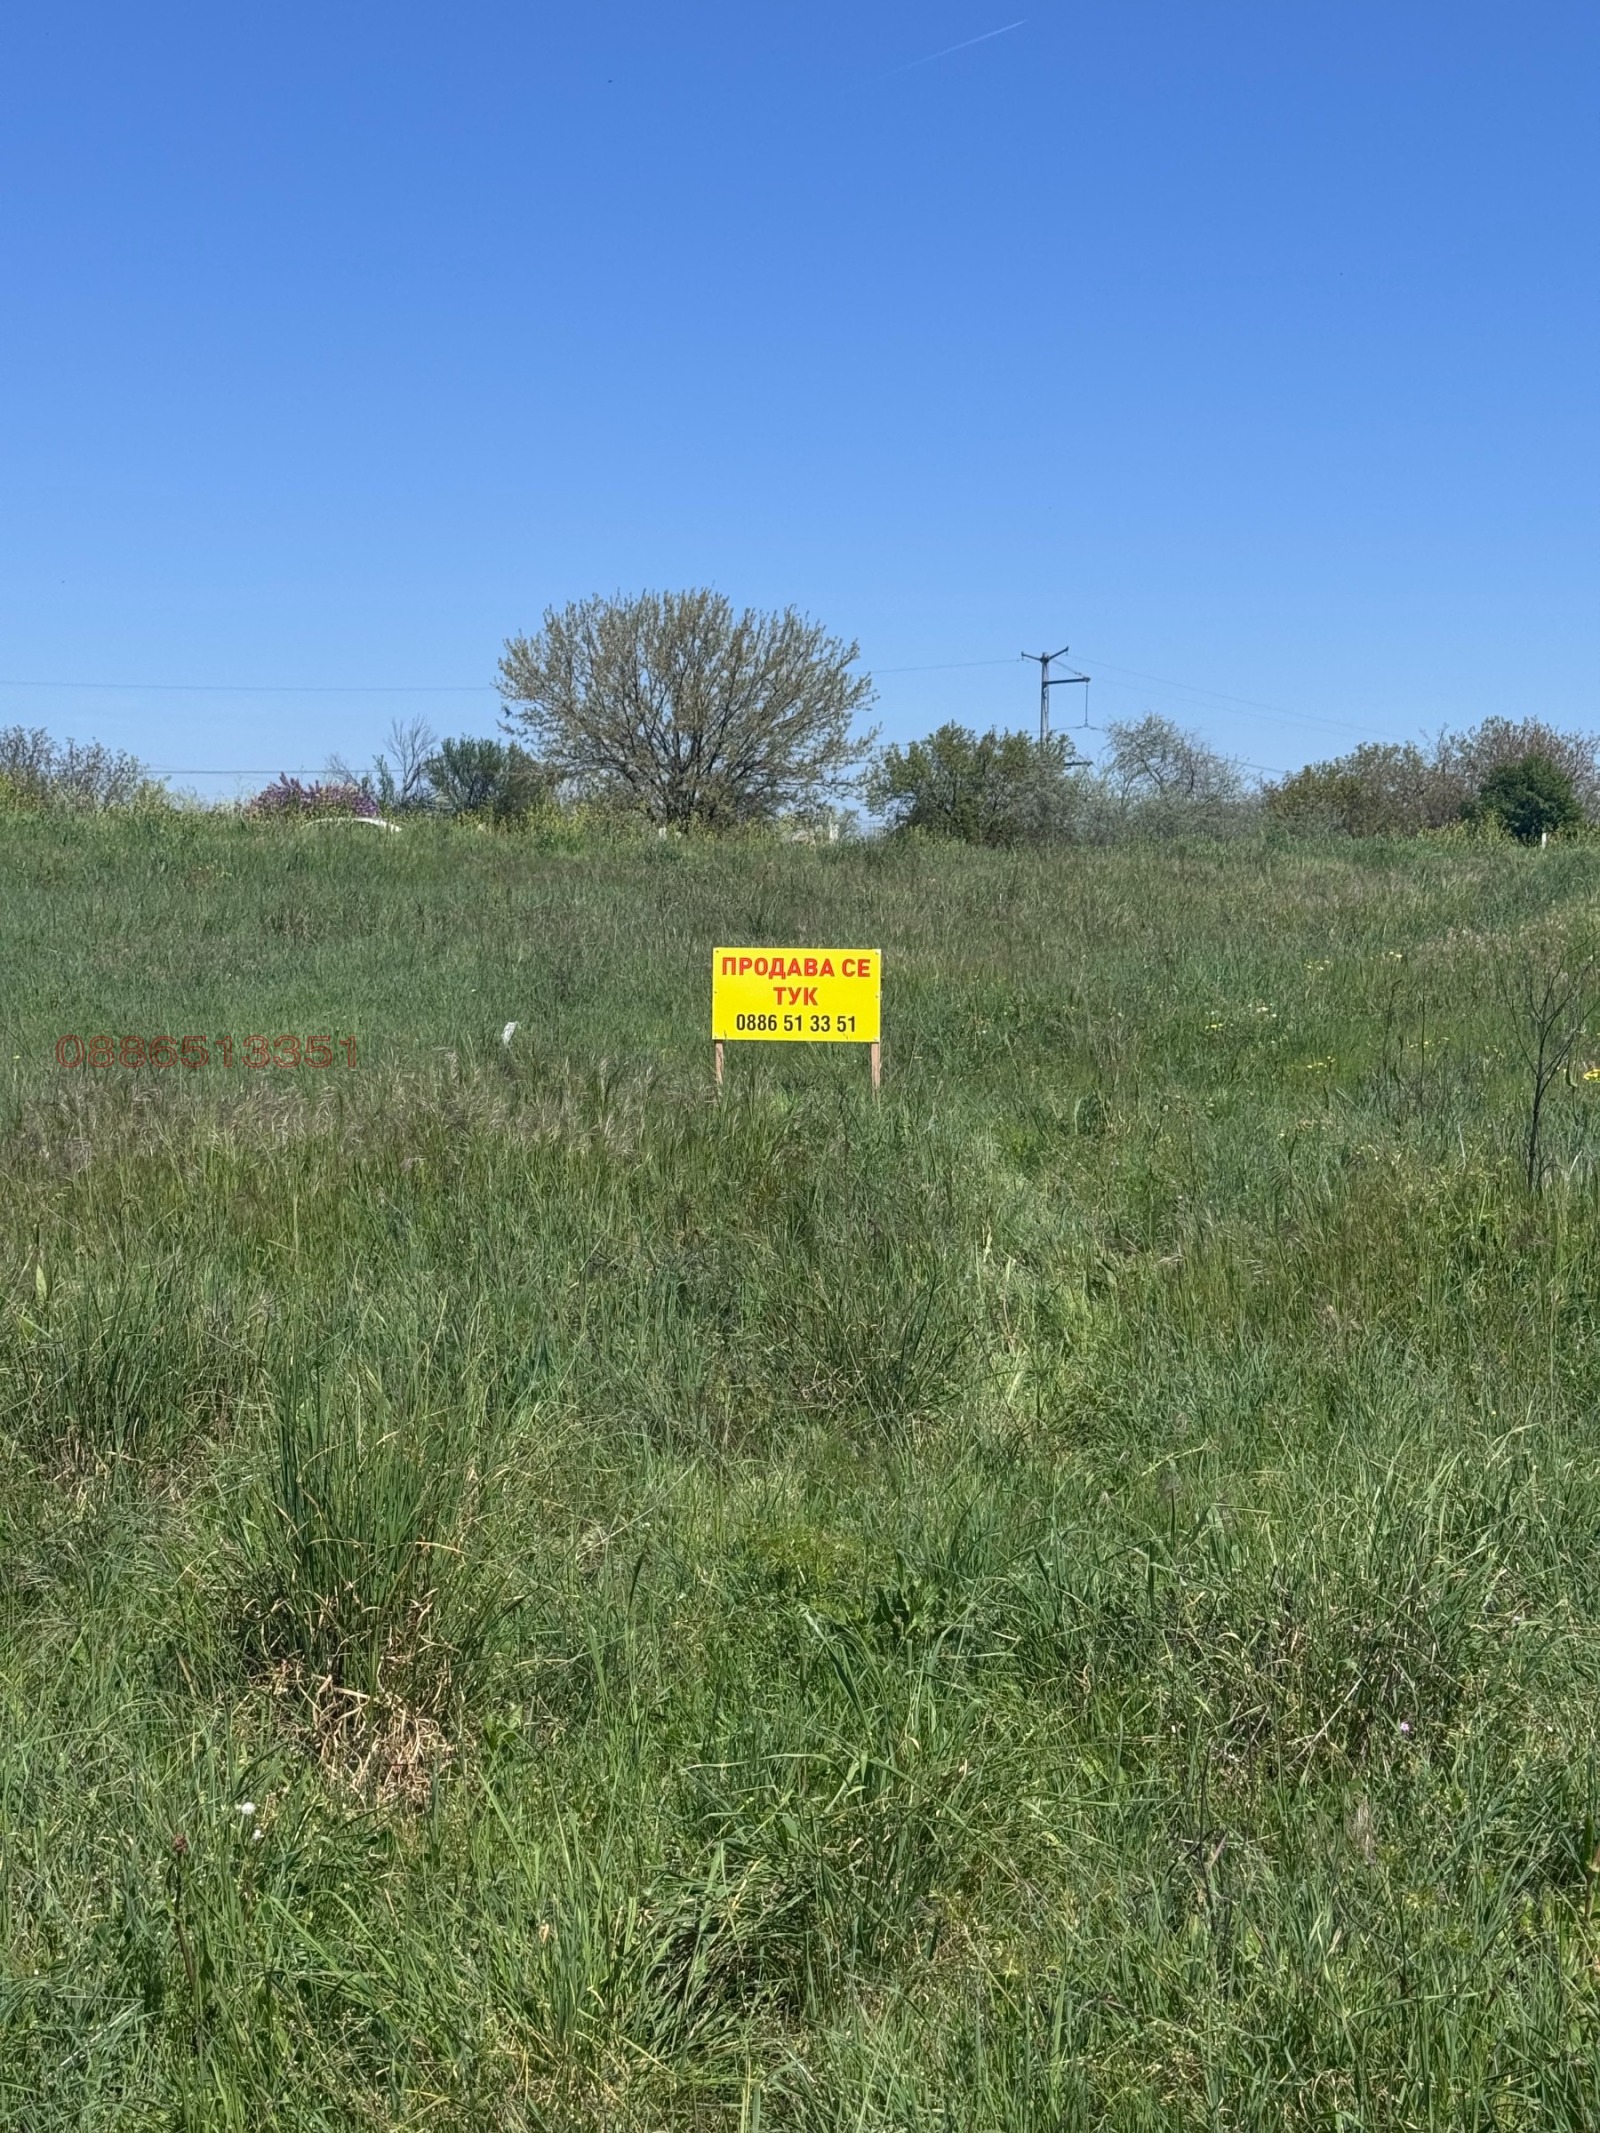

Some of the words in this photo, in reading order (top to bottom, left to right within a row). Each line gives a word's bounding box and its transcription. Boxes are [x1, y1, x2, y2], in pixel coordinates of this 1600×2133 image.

[722, 957, 835, 980] ПРОДАВА
[841, 958, 871, 978] СЕ
[773, 987, 818, 1006] ТУК
[736, 1014, 777, 1031] 0886
[783, 1015, 802, 1032] 51
[810, 1015, 831, 1032] 33
[837, 1015, 855, 1033] 51
